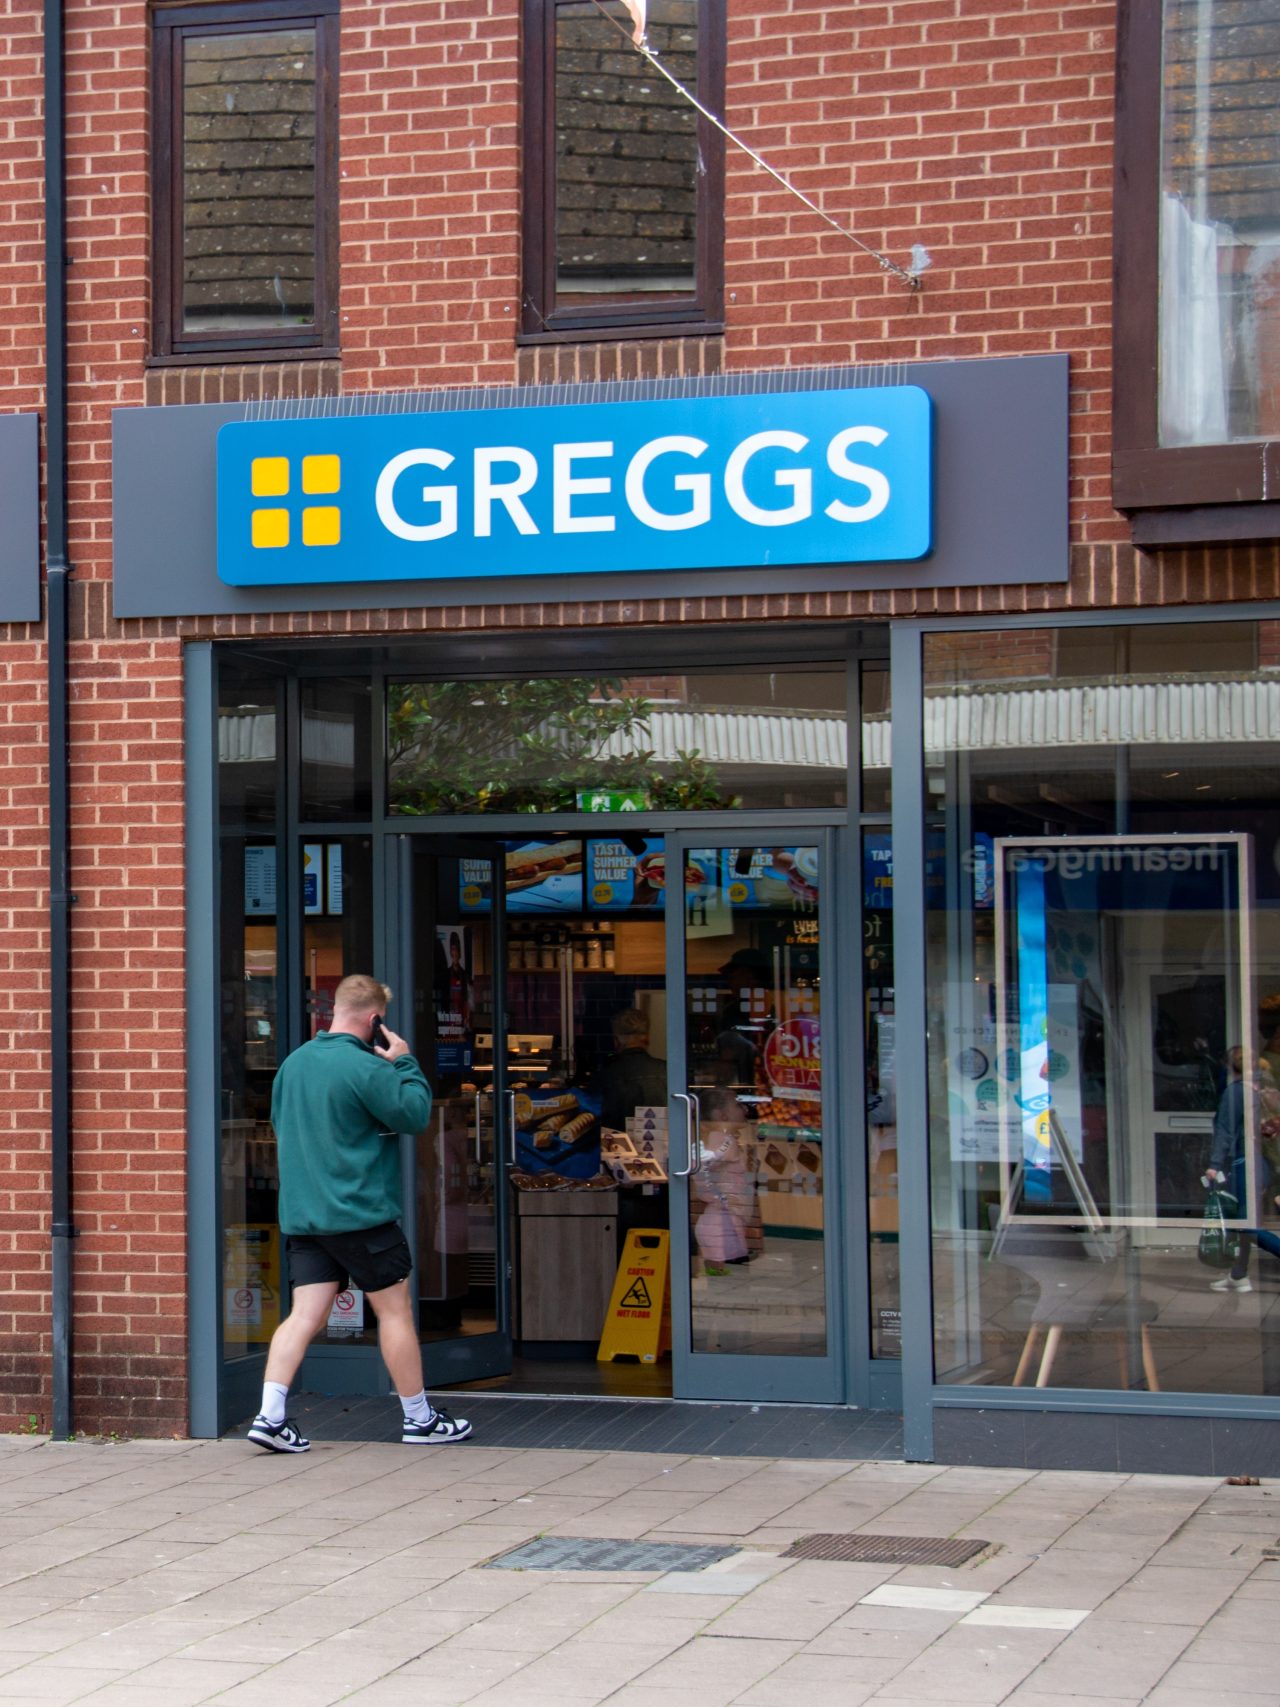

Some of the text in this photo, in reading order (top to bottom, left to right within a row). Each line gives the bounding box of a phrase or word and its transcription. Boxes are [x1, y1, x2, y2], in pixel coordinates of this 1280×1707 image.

[375, 426, 890, 542] GREGGS
[593, 844, 627, 855] TASTY
[593, 856, 637, 868] SUMMER
[594, 868, 627, 880] VALUE
